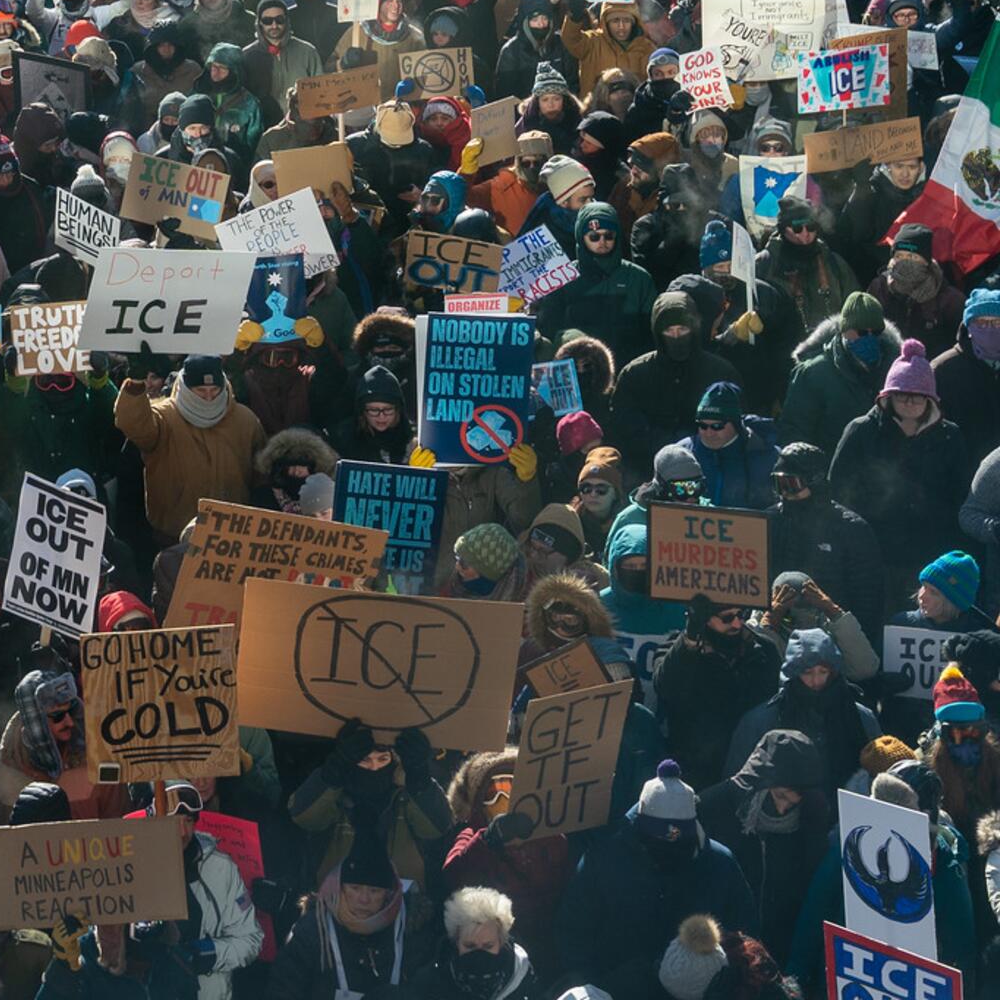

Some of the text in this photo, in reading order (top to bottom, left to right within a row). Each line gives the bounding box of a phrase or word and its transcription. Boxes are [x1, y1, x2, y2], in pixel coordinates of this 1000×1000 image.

[685, 51, 714, 70] GOD
[813, 51, 870, 69] ABOLISH
[682, 69, 720, 84] KNOWS
[687, 84, 722, 99] YOUR
[831, 67, 866, 96] ICE
[690, 97, 727, 110] SINS
[59, 190, 113, 232] HUMAN
[58, 214, 117, 248] BEINGS!
[412, 233, 490, 268] ICE
[107, 253, 223, 294] Deport
[408, 258, 498, 289] OUT
[106, 299, 207, 334] ICE
[448, 299, 500, 312] ORGANIZE
[432, 318, 529, 345] NOBODY IS
[430, 348, 496, 370] ILLEGAL
[428, 372, 455, 395] ON
[459, 374, 524, 398] STOLEN
[427, 399, 473, 422] LAND
[348, 470, 437, 500] HATE WILL
[36, 492, 88, 535] ICE
[344, 497, 435, 540] NEVER
[684, 516, 734, 542] ICE
[26, 518, 94, 561] OUT
[202, 535, 243, 558] FOR
[249, 543, 301, 566] THESE
[658, 541, 757, 570] MURDERS
[20, 552, 90, 599] OF MN
[194, 560, 236, 581] ARE
[655, 569, 761, 597] AMERICANS
[10, 577, 88, 625] NOW
[83, 629, 221, 670] GO HOME
[310, 616, 445, 694] ICE
[115, 668, 149, 702] IF
[101, 697, 229, 745] COLD
[527, 690, 623, 754] GET
[528, 745, 590, 790] TF
[512, 779, 600, 830] OUT
[21, 835, 135, 867] A UNIQUE
[14, 863, 135, 896] MINNEAPOLIS
[22, 895, 135, 921] REACTION
[843, 944, 947, 998] ICE
